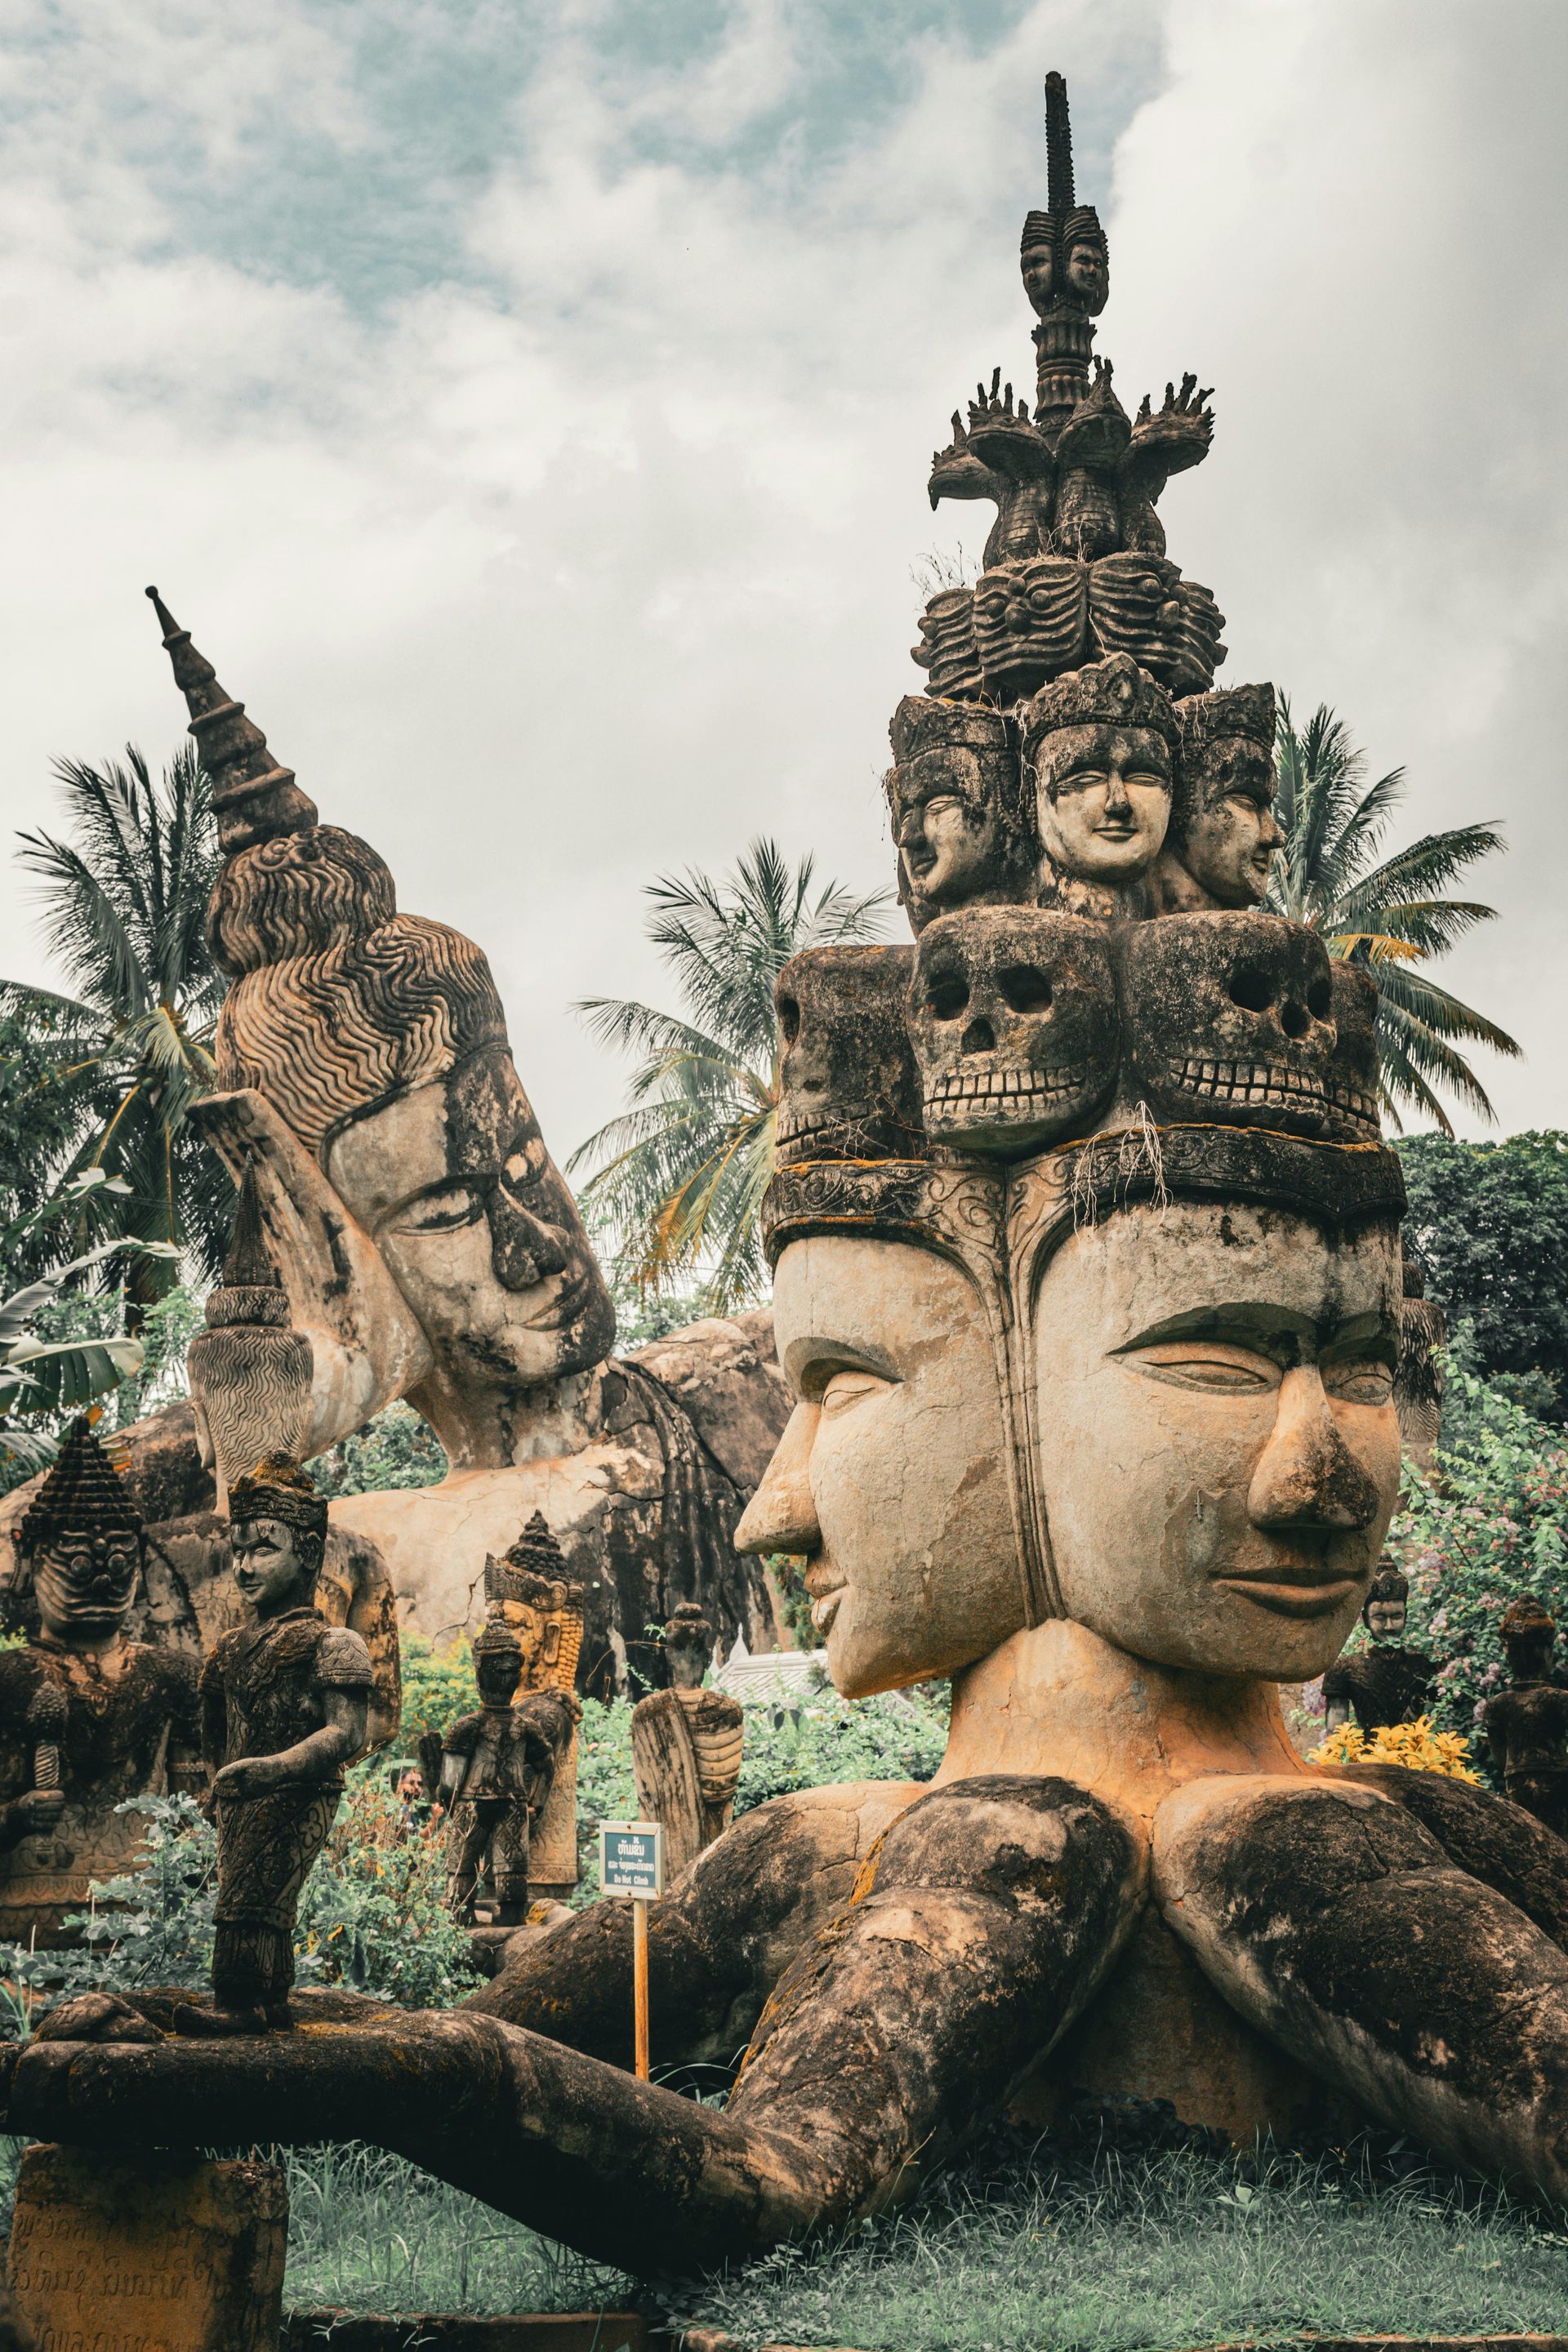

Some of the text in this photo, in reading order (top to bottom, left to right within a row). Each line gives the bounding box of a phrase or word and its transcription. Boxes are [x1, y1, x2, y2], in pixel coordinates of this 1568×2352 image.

[614, 1874, 648, 1885] Do Not Climb
